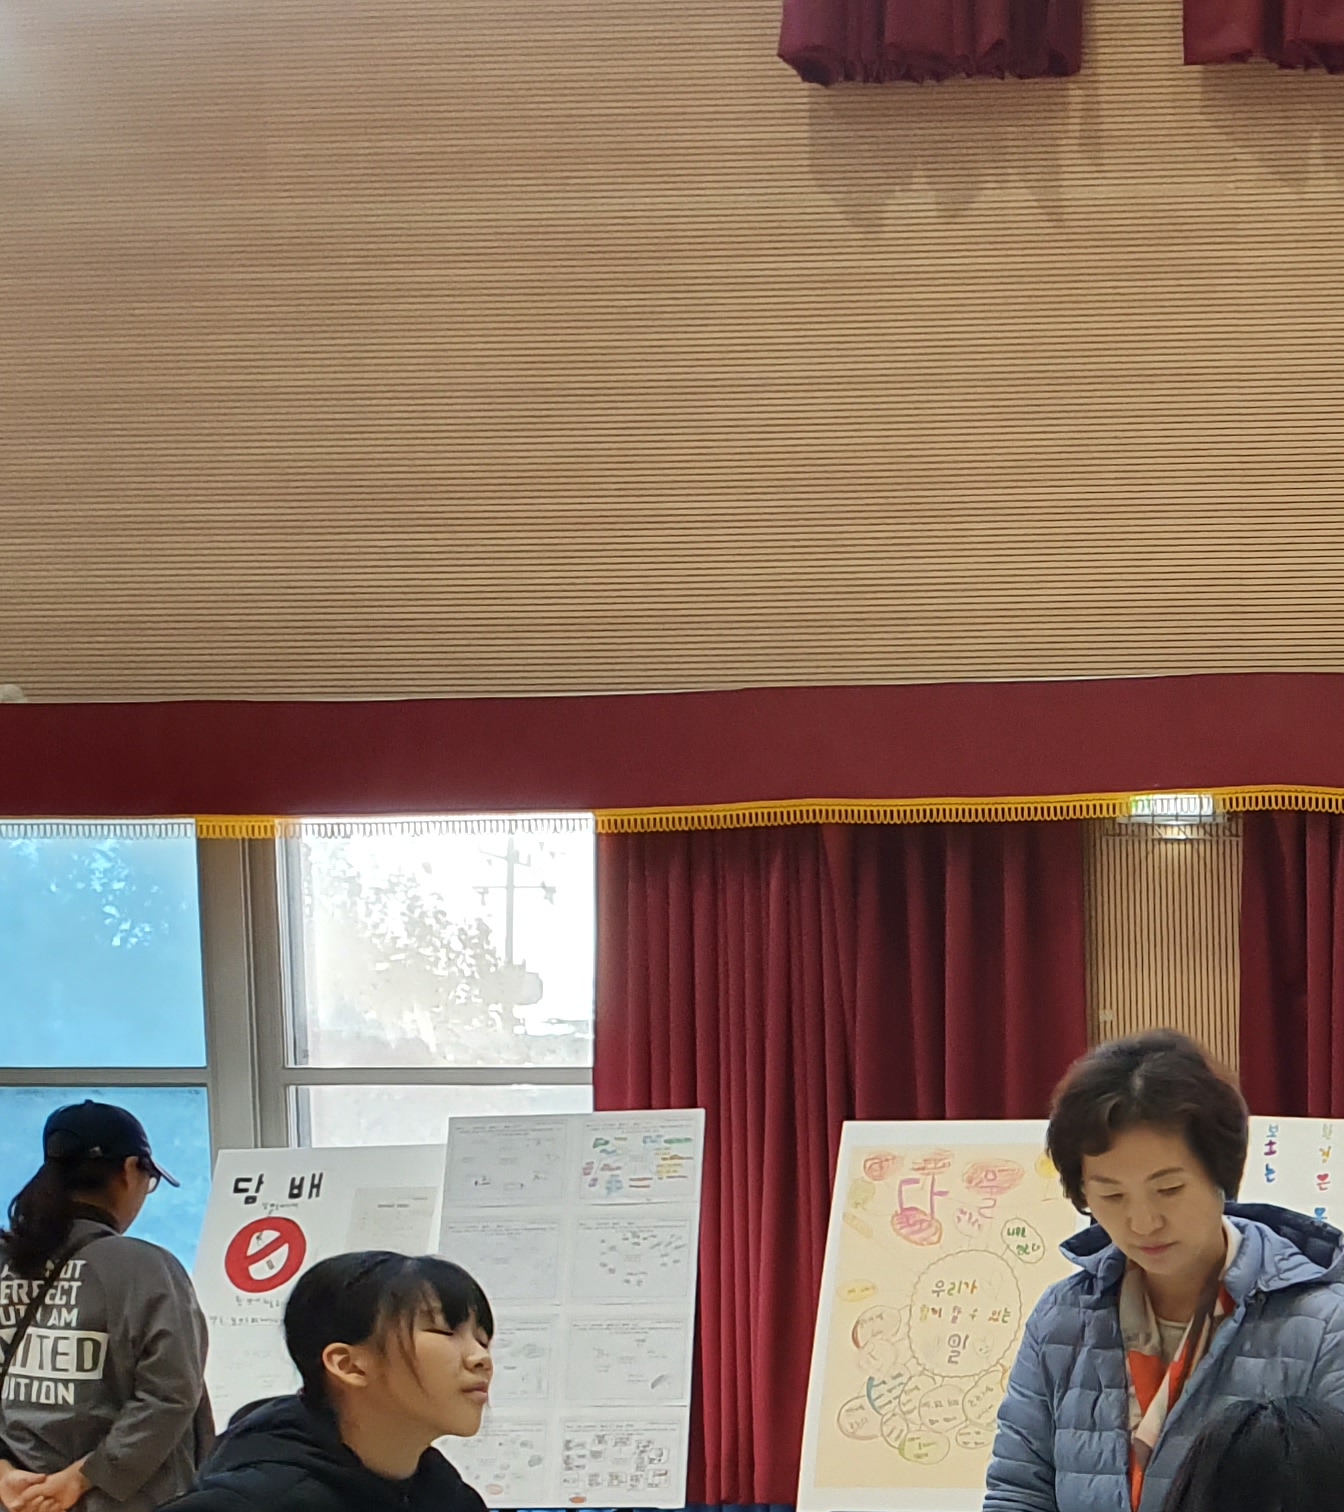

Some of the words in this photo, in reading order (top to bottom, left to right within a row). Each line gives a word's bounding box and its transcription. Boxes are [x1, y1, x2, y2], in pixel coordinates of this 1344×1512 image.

[932, 1280, 978, 1297] 우리가
[47, 1307, 79, 1327] AM
[948, 1333, 969, 1364] 일
